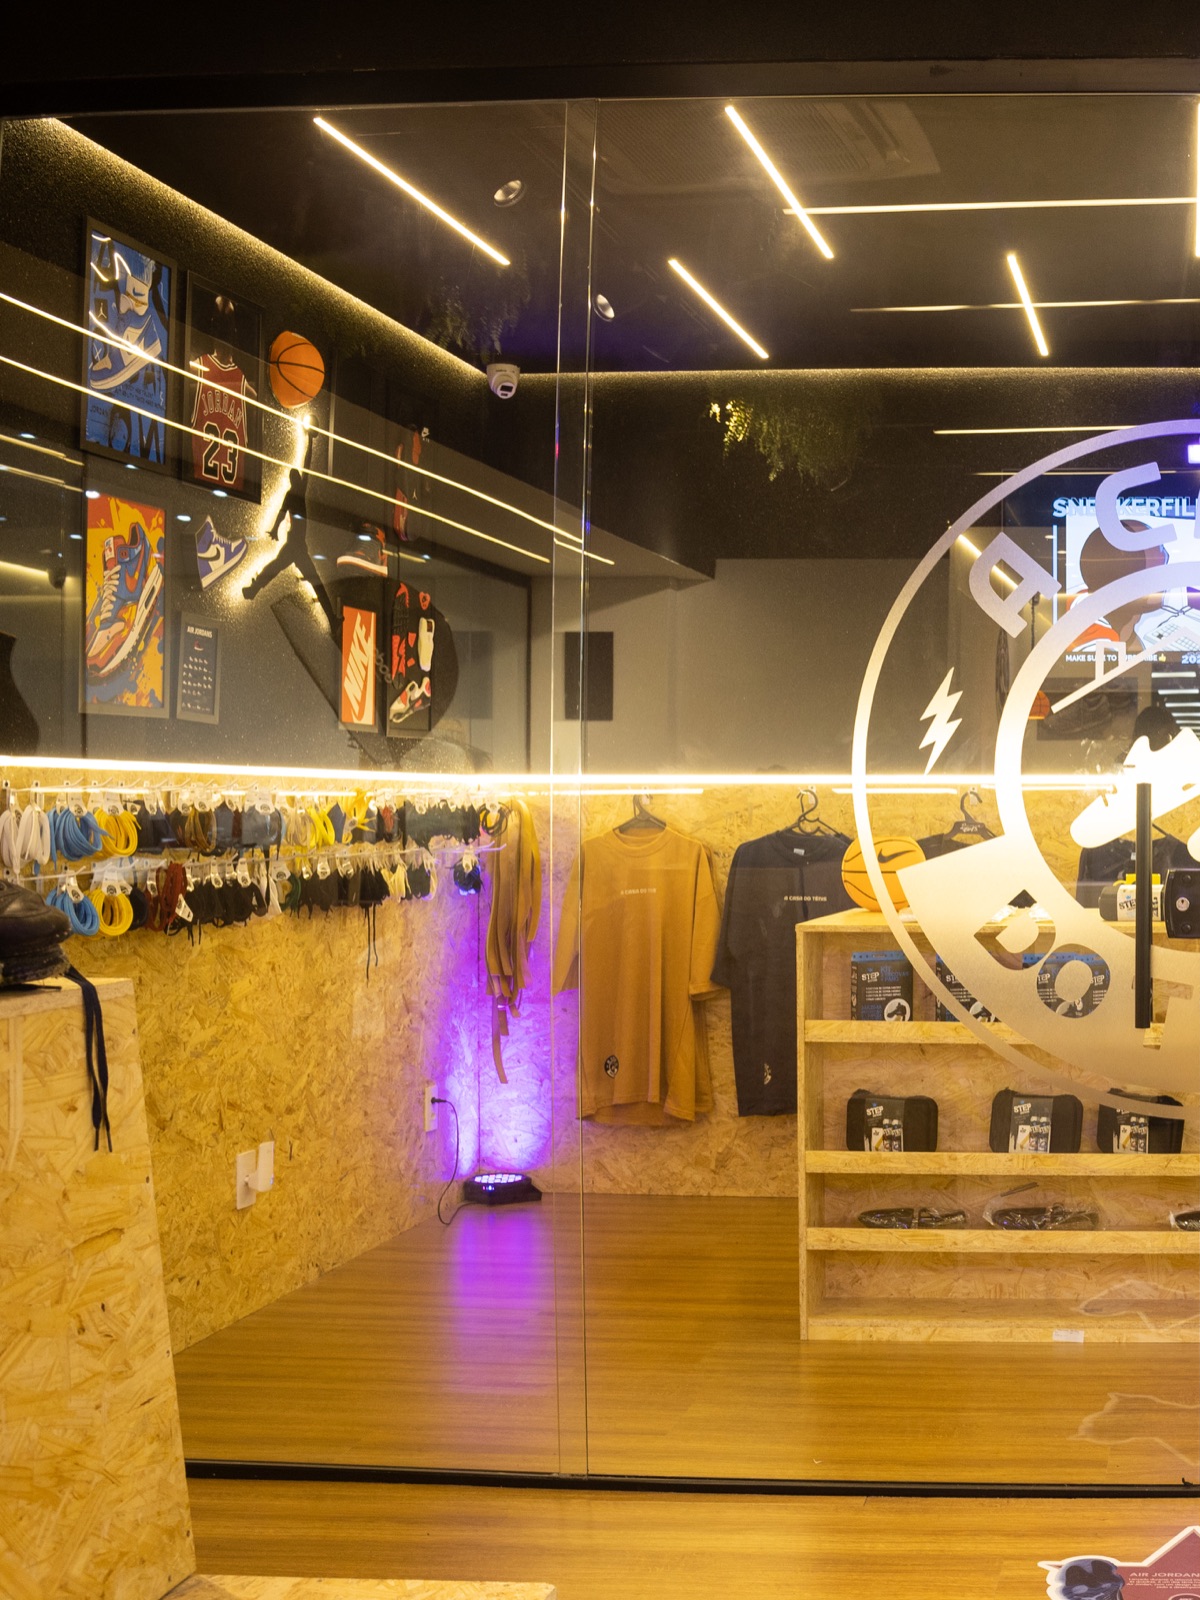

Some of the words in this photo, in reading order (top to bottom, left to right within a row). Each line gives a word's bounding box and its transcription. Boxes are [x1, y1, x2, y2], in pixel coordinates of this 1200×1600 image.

[201, 389, 243, 429] JORDAN
[202, 421, 239, 485] 23
[969, 532, 1062, 638] A
[343, 611, 370, 718] NIKE
[1065, 654, 1086, 662] MAKE
[1107, 654, 1117, 662] TO
[974, 889, 1110, 1018] DO
[861, 971, 880, 981] STEP
[866, 1106, 883, 1116] STEP
[1013, 1103, 1032, 1113] STEP
